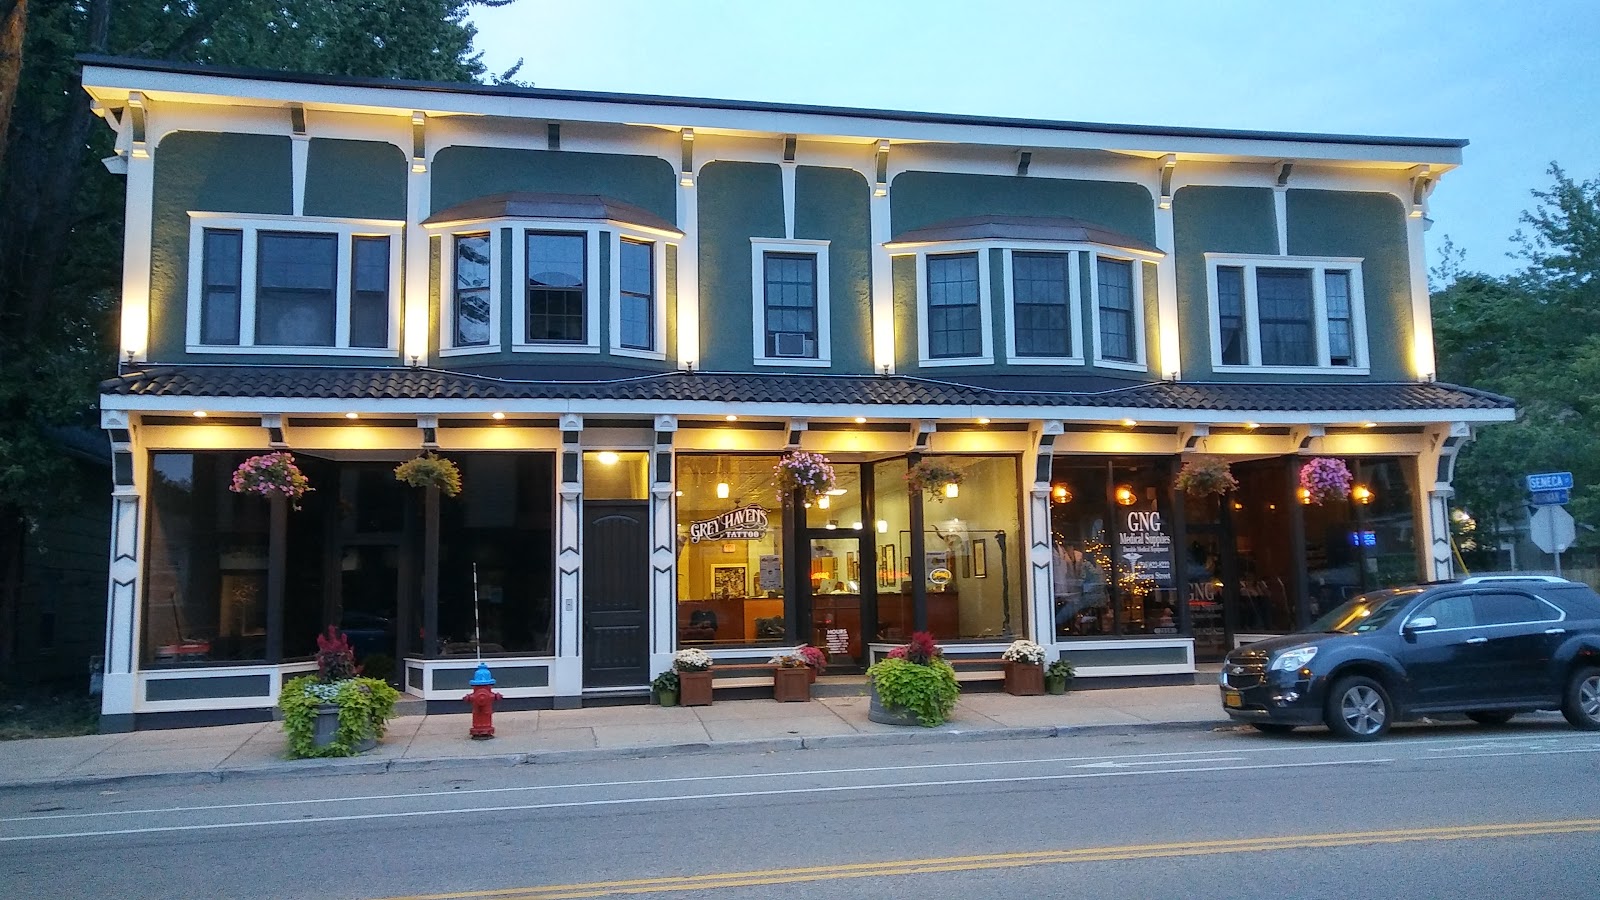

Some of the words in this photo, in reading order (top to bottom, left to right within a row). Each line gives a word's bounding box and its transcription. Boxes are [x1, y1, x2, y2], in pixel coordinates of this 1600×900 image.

[1530, 476, 1563, 488] SENECA
[691, 520, 720, 543] GREY
[723, 508, 769, 529] HAVENS
[1127, 511, 1161, 532] GNG
[1119, 533, 1144, 545] Medical
[1145, 533, 1171, 547] Supplies
